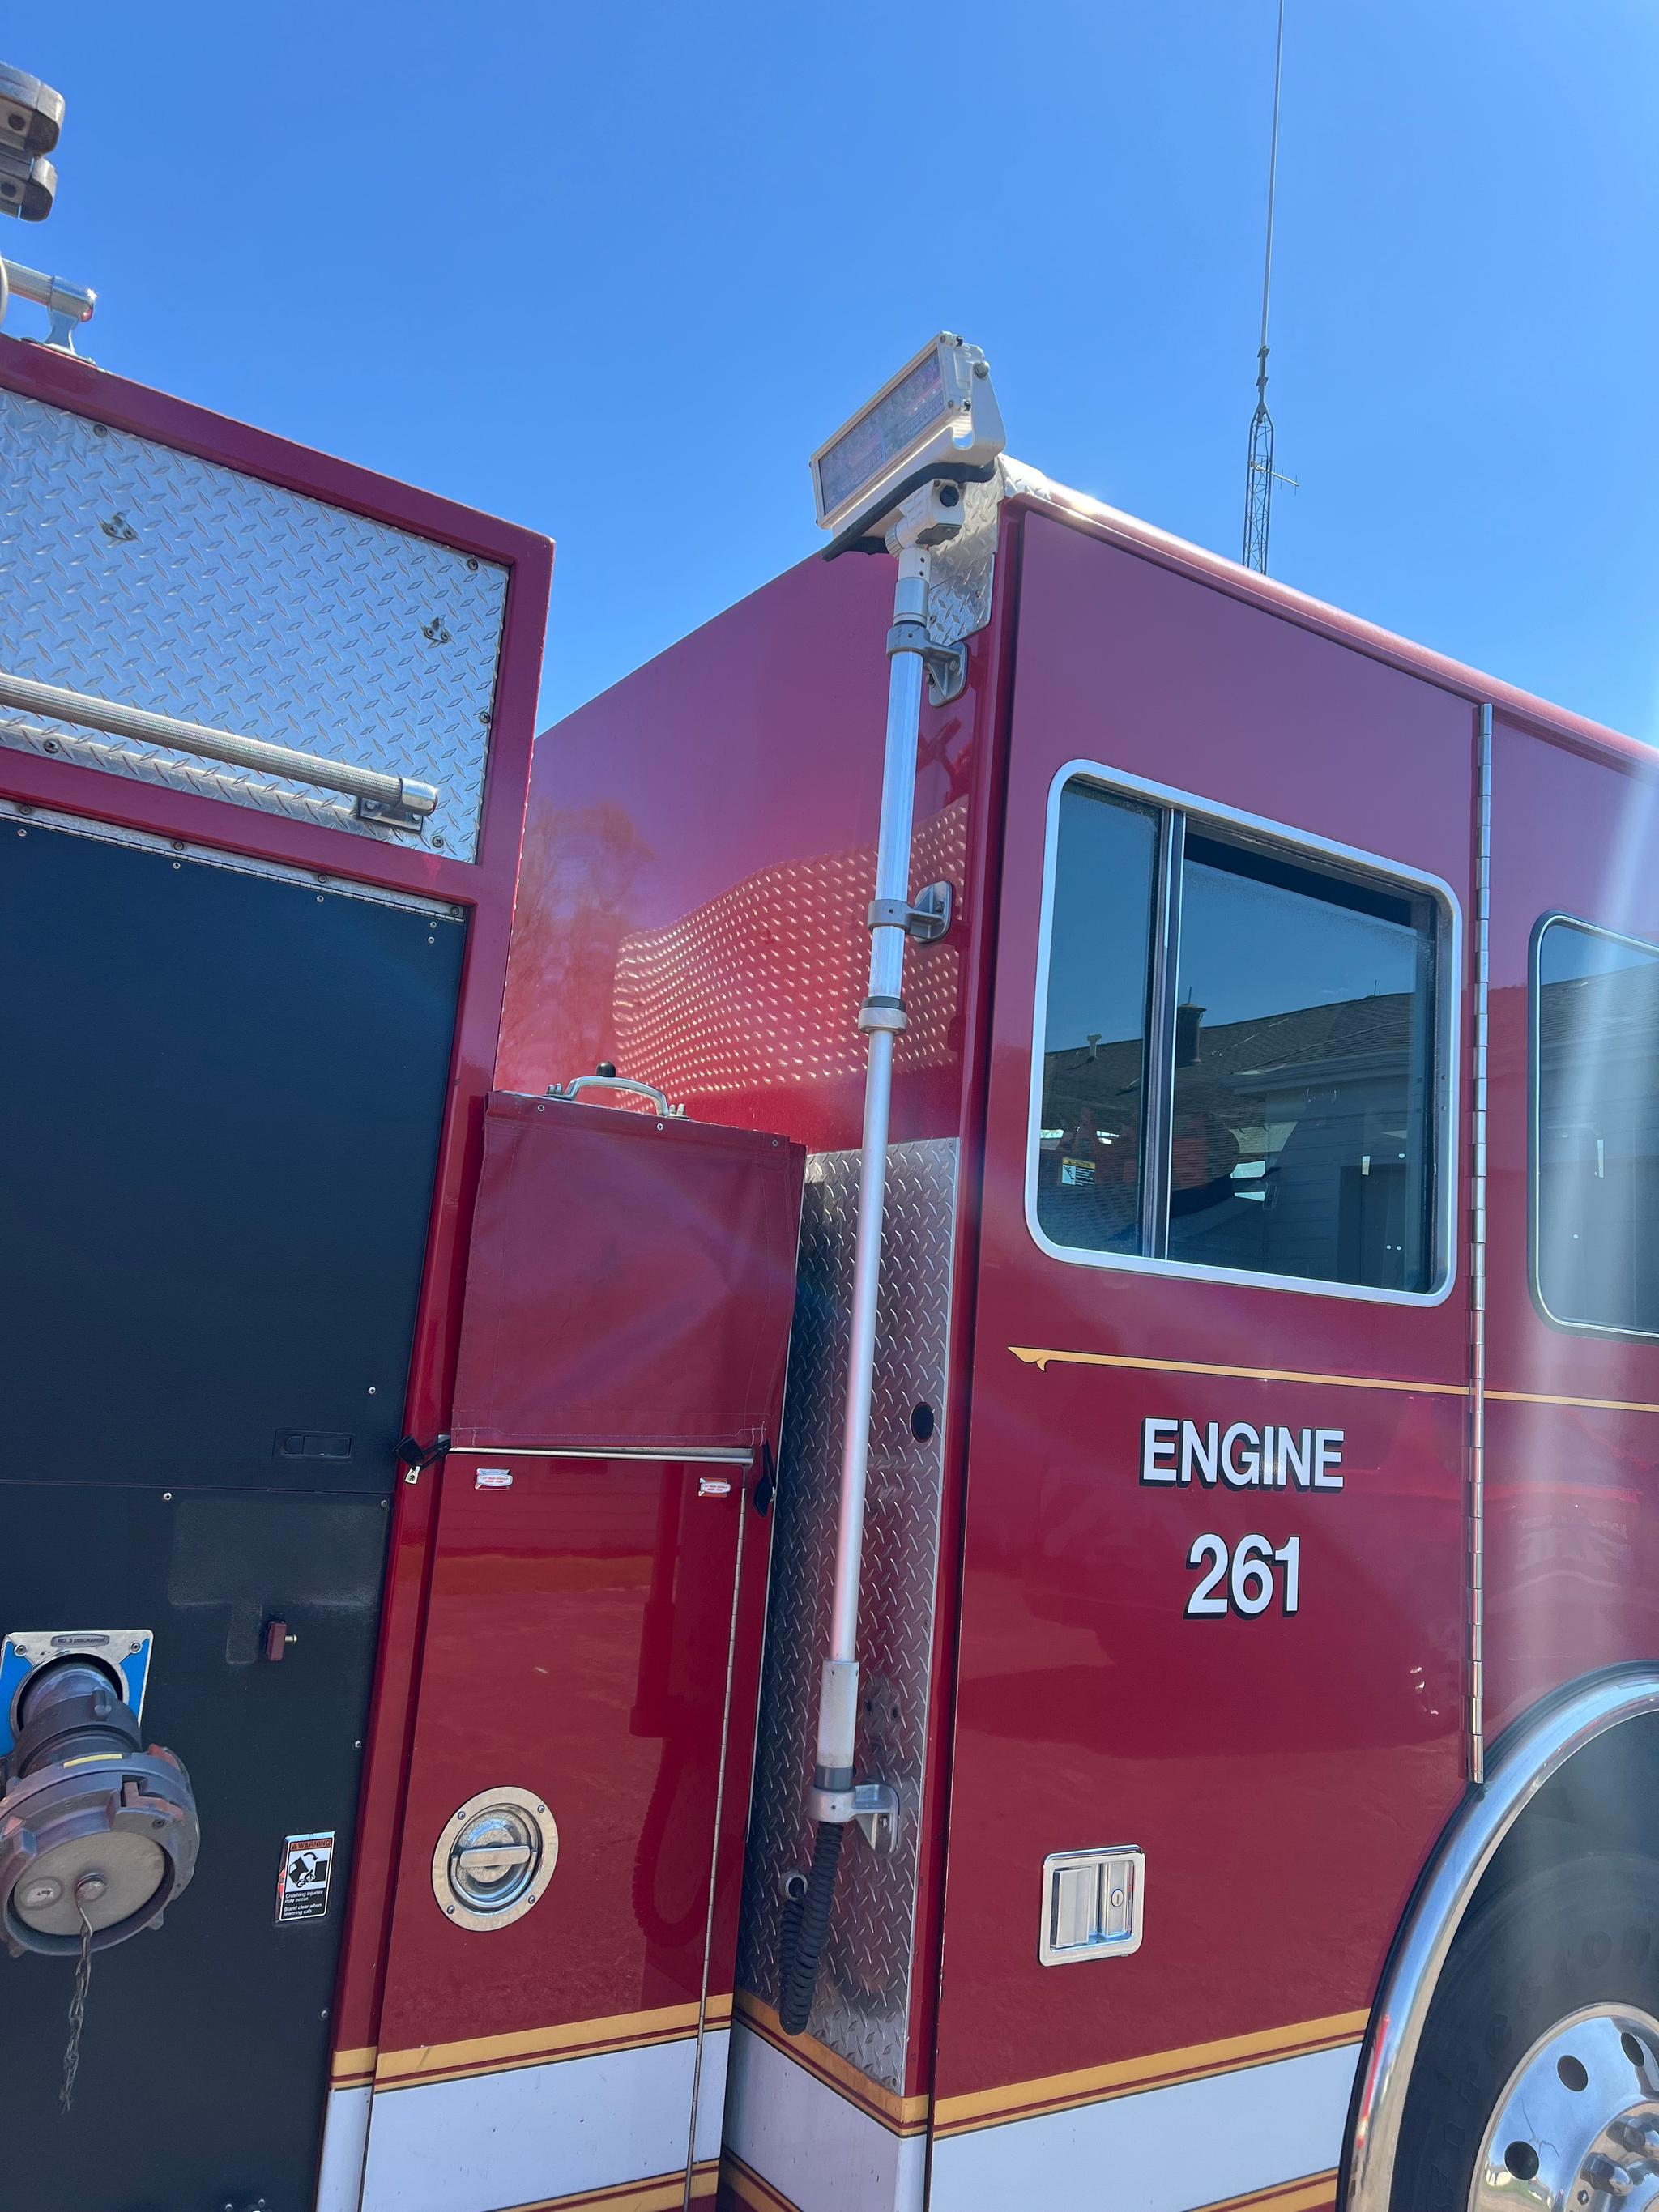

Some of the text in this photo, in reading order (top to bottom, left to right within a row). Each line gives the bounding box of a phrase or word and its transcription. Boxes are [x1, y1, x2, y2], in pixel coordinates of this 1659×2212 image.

[1140, 1417, 1346, 1492] ENGINE
[1184, 1532, 1301, 1619] 261
[297, 1839, 331, 1849] WARNING
